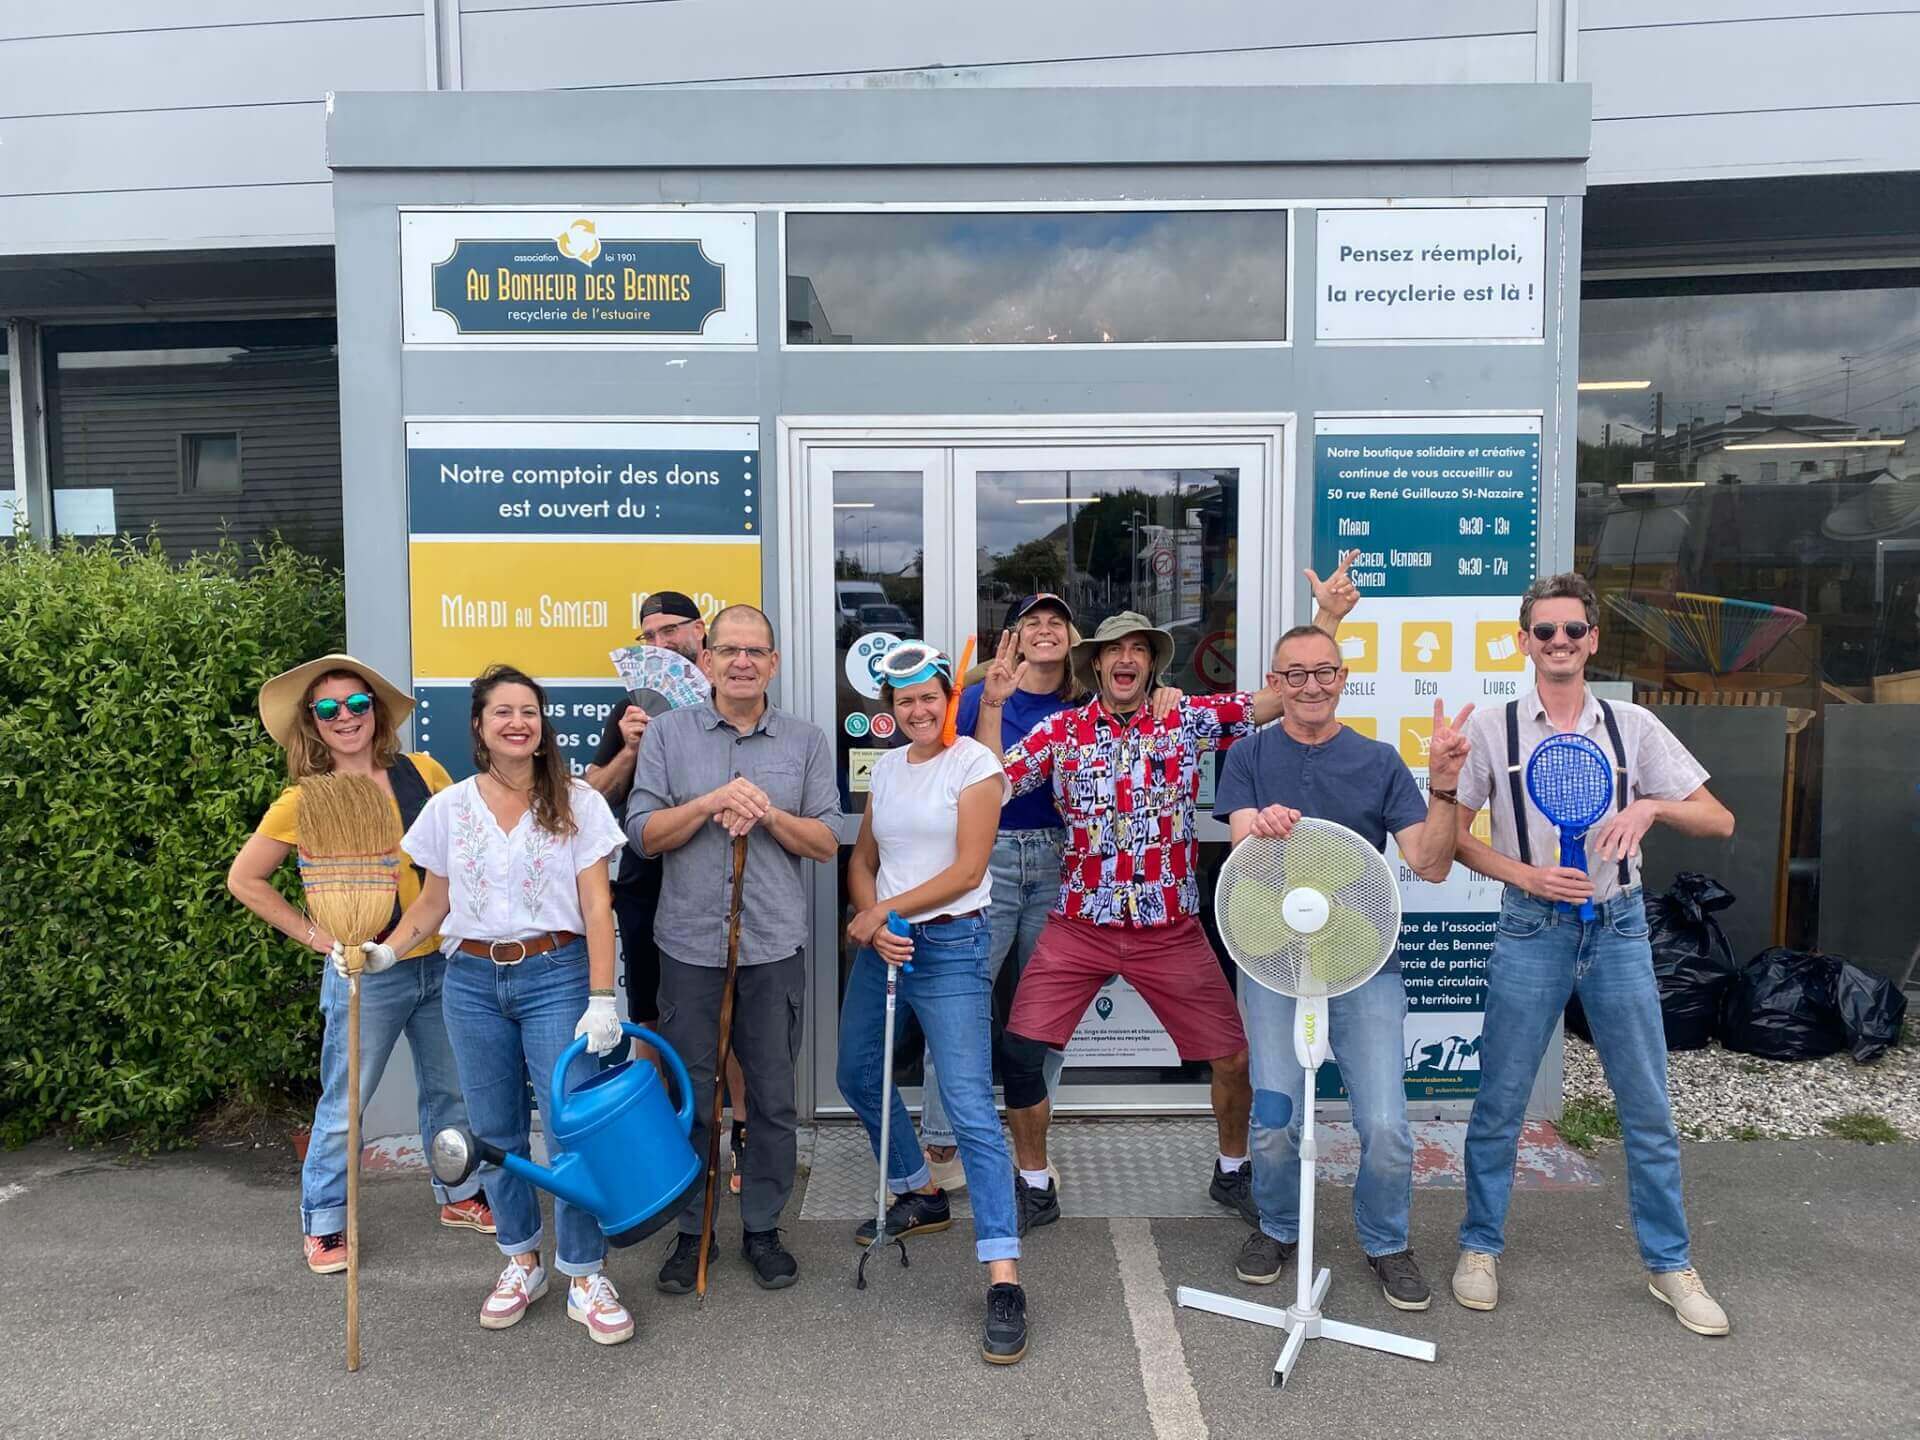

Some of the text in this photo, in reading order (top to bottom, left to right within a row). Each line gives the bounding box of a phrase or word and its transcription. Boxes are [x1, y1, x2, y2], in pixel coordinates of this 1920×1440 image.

[514, 253, 559, 263] association
[605, 253, 637, 263] loi 1901
[1340, 243, 1523, 265] Pensez réemploi,
[1327, 283, 1533, 305] la recyclerie est là !
[507, 307, 651, 323] recyclerie de l'estuaire
[1327, 446, 1526, 460] Notre boutique solidaire et créative
[440, 463, 720, 489] Notre comptoir des dons
[1338, 466, 1513, 478] continue de vous accueillir au
[1327, 487, 1524, 500] 50 rue René Guillouzo St-Nazaire
[498, 499, 531, 518] est
[538, 499, 610, 518] ouvert
[617, 498, 646, 518] du
[1422, 921, 1438, 932] de
[1428, 938, 1450, 951] des
[1430, 957, 1446, 969] de
[1422, 992, 1472, 1005] territoire
